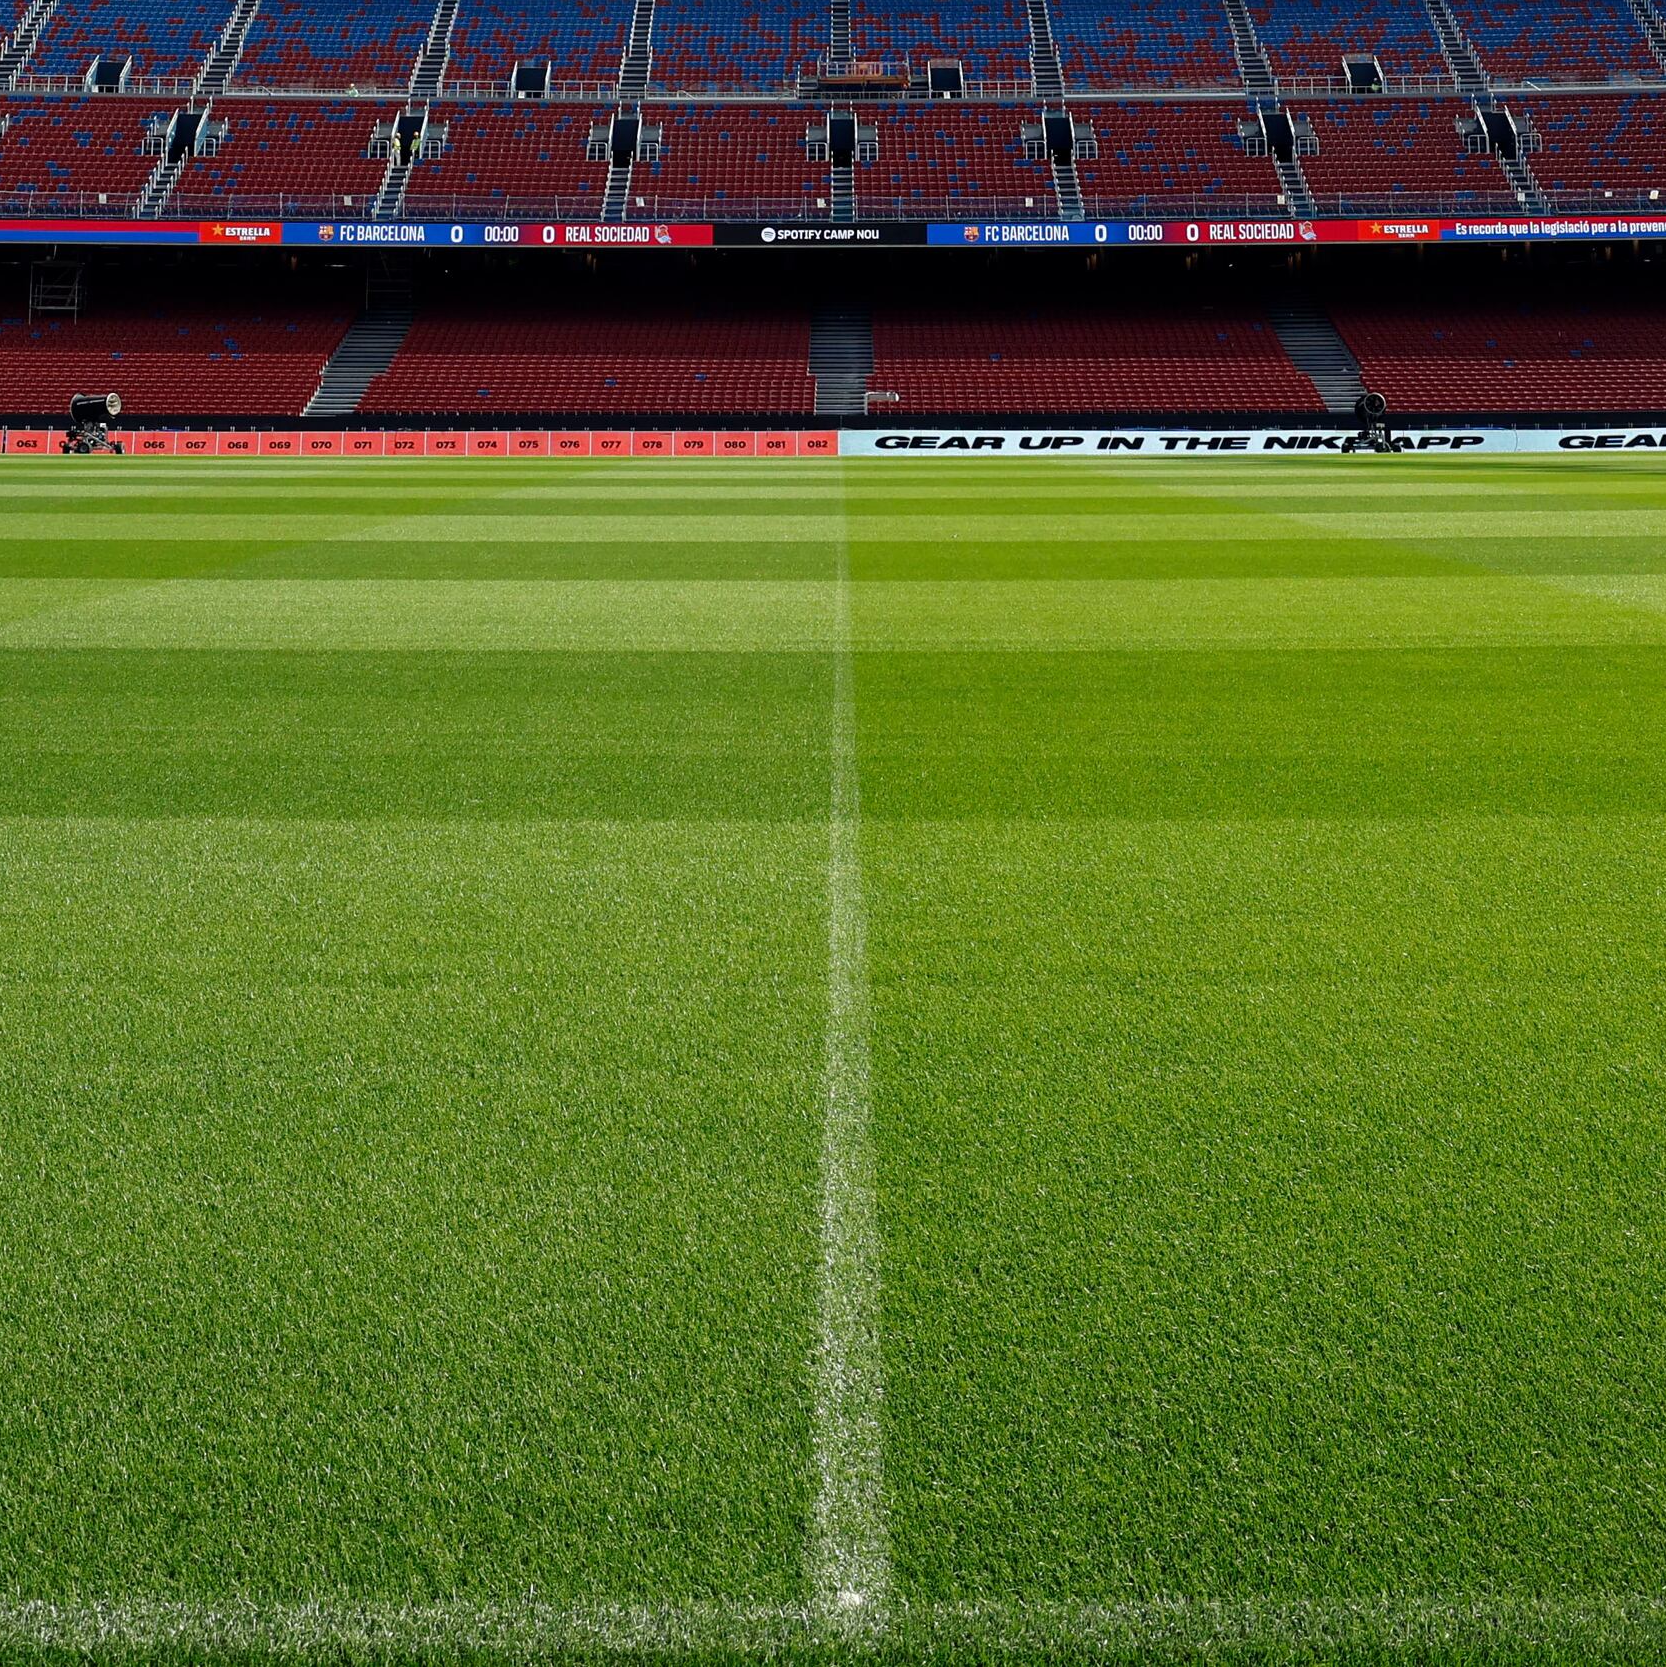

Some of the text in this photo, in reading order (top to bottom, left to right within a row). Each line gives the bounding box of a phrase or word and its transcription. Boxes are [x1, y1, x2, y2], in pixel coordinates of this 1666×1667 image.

[225, 227, 271, 236] ESTRELLA
[985, 223, 1294, 242] FC BARCELONA 0 00:00 0 REAL SOCIEDAD
[1383, 224, 1429, 234] ESTRELLA
[1455, 222, 1467, 235] Es
[1468, 221, 1508, 235] recorda
[1509, 224, 1529, 237] que
[1530, 221, 1540, 234] la
[1541, 220, 1590, 236] legislació
[1591, 222, 1609, 236] per
[1609, 222, 1617, 232] a
[1618, 220, 1628, 232] la
[340, 225, 650, 244] FC BARCELONA 0 00:00 0 REAL SOCIEDAD
[777, 229, 880, 240] SPOTIFY CAMP NOU
[16, 440, 37, 449] 063
[143, 440, 165, 449] 066
[186, 440, 206, 449] 067
[227, 440, 248, 449] 068
[269, 440, 291, 449] 069
[311, 440, 332, 449] 070
[354, 440, 372, 449] 071
[395, 440, 414, 449] 072
[436, 440, 455, 449] 073
[477, 440, 497, 449] 074
[519, 440, 538, 449] 075
[560, 440, 579, 449] 076
[601, 440, 621, 449] 077
[643, 440, 662, 449] 078
[684, 440, 703, 449] 079
[724, 440, 746, 449] 080
[767, 440, 785, 449] 081
[807, 440, 828, 449] 082
[874, 435, 1006, 450] GEAR
[1018, 436, 1085, 450] UP
[1096, 436, 1145, 450] IN
[1159, 436, 1251, 450] THE
[1390, 436, 1485, 450] APP
